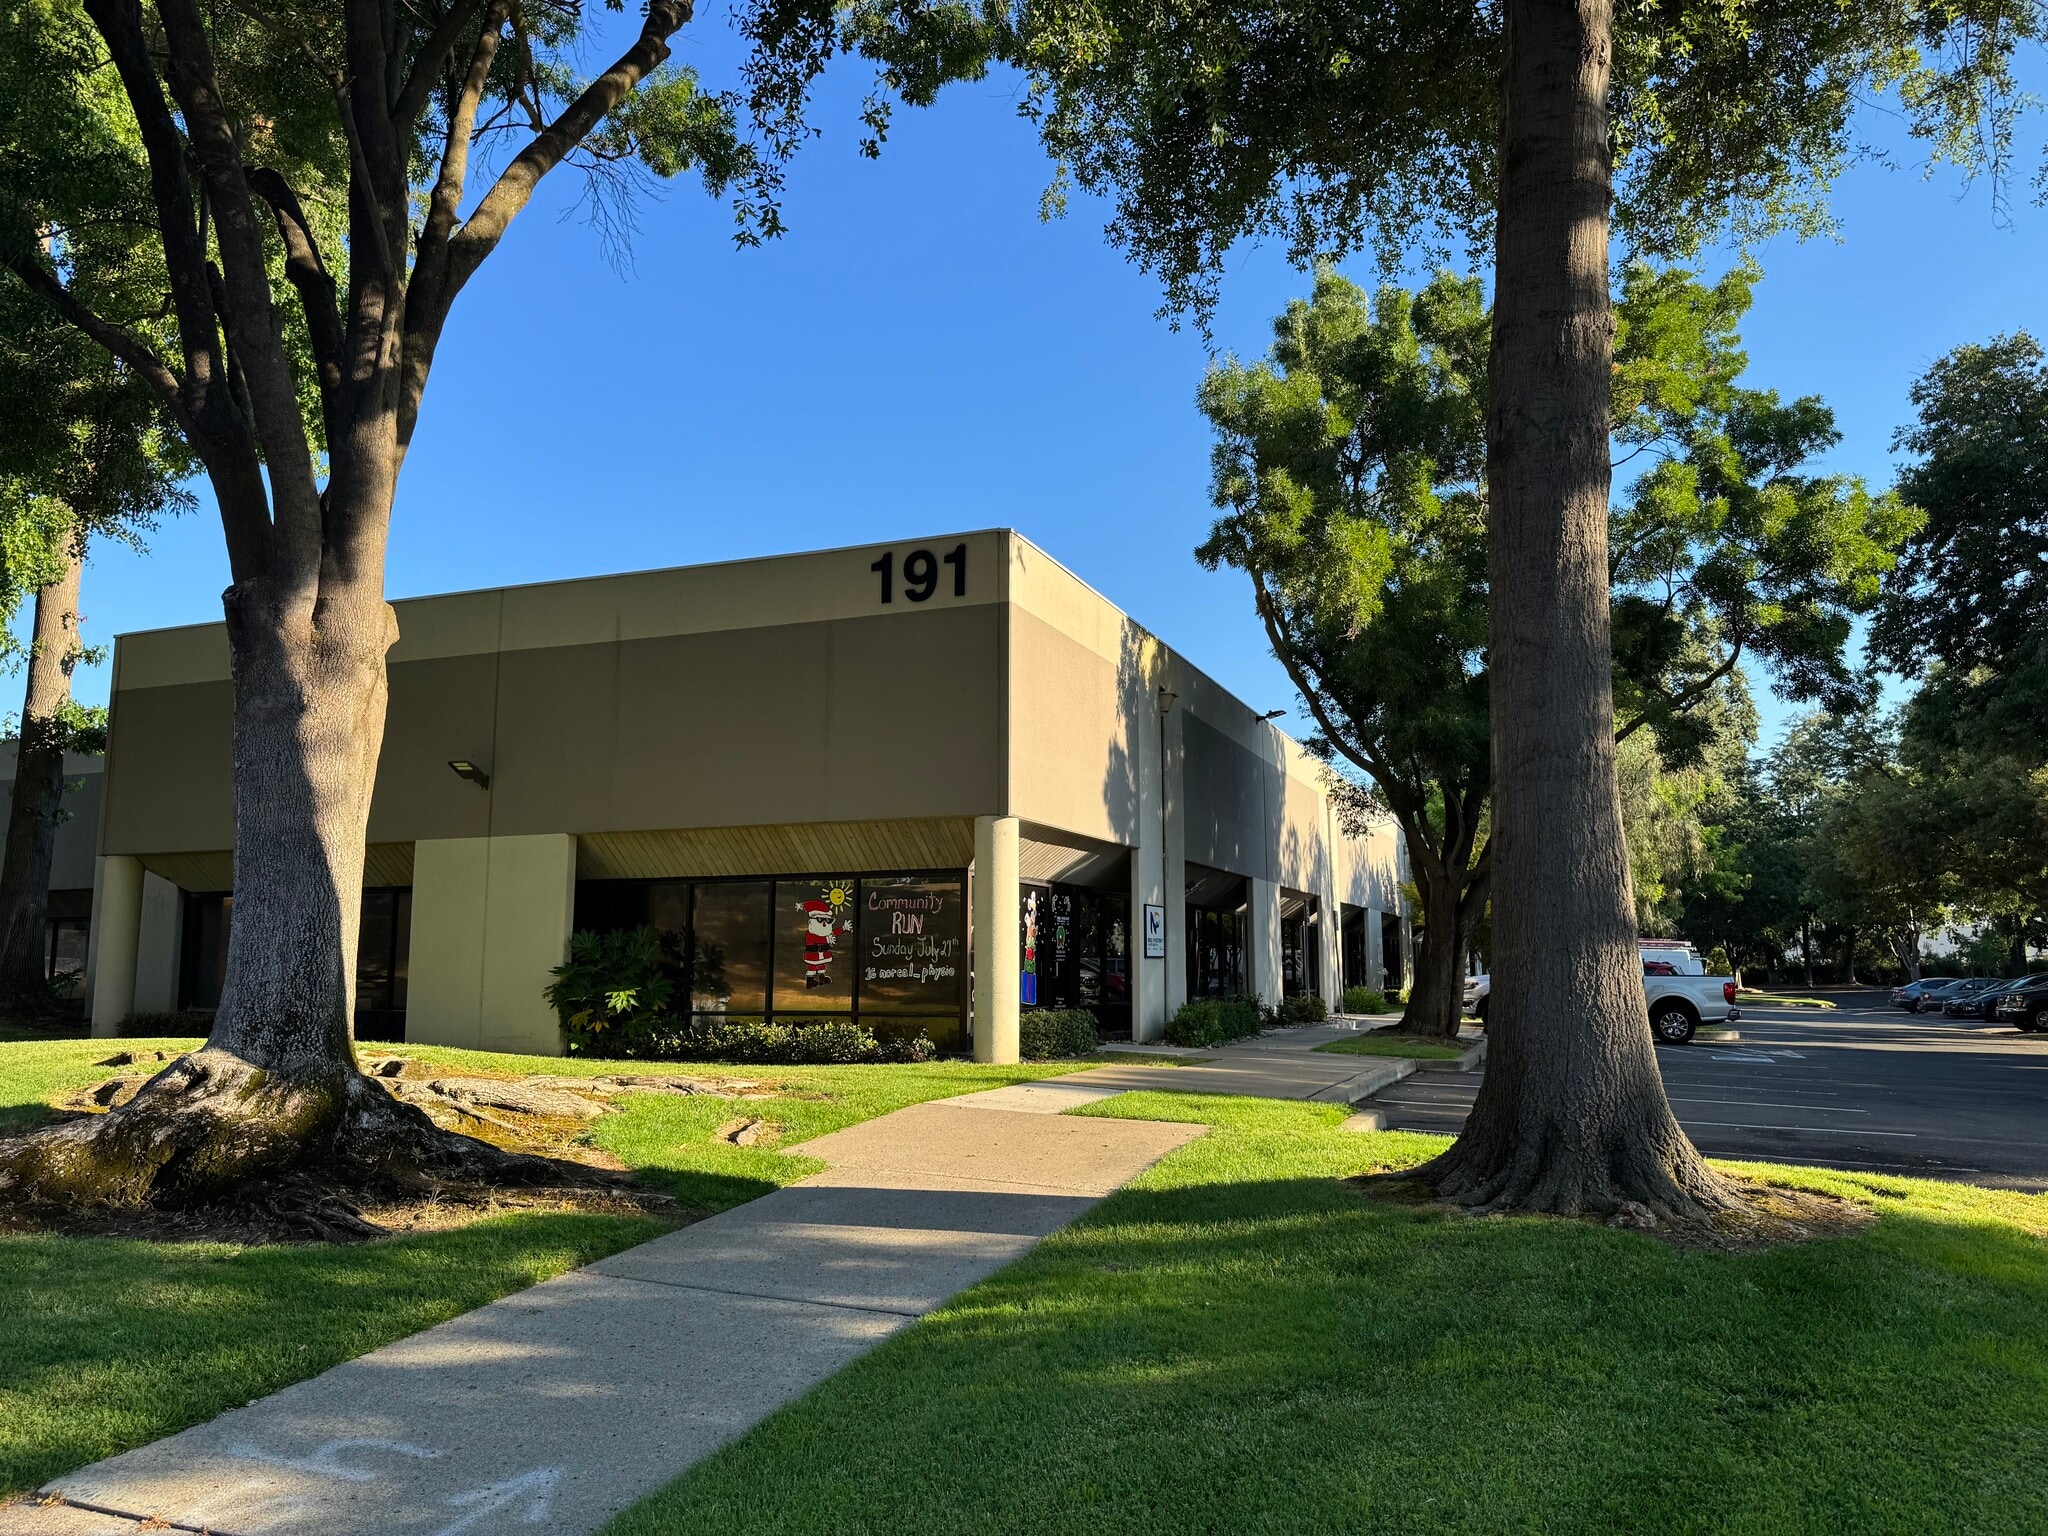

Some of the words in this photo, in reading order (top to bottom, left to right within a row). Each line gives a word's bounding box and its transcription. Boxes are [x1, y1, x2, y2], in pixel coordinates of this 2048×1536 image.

[871, 543, 966, 604] 191
[868, 891, 944, 914] Community
[891, 911, 924, 935] RUN
[871, 936, 914, 961] Sunday
[917, 935, 940, 963] July
[940, 936, 960, 958] 27th
